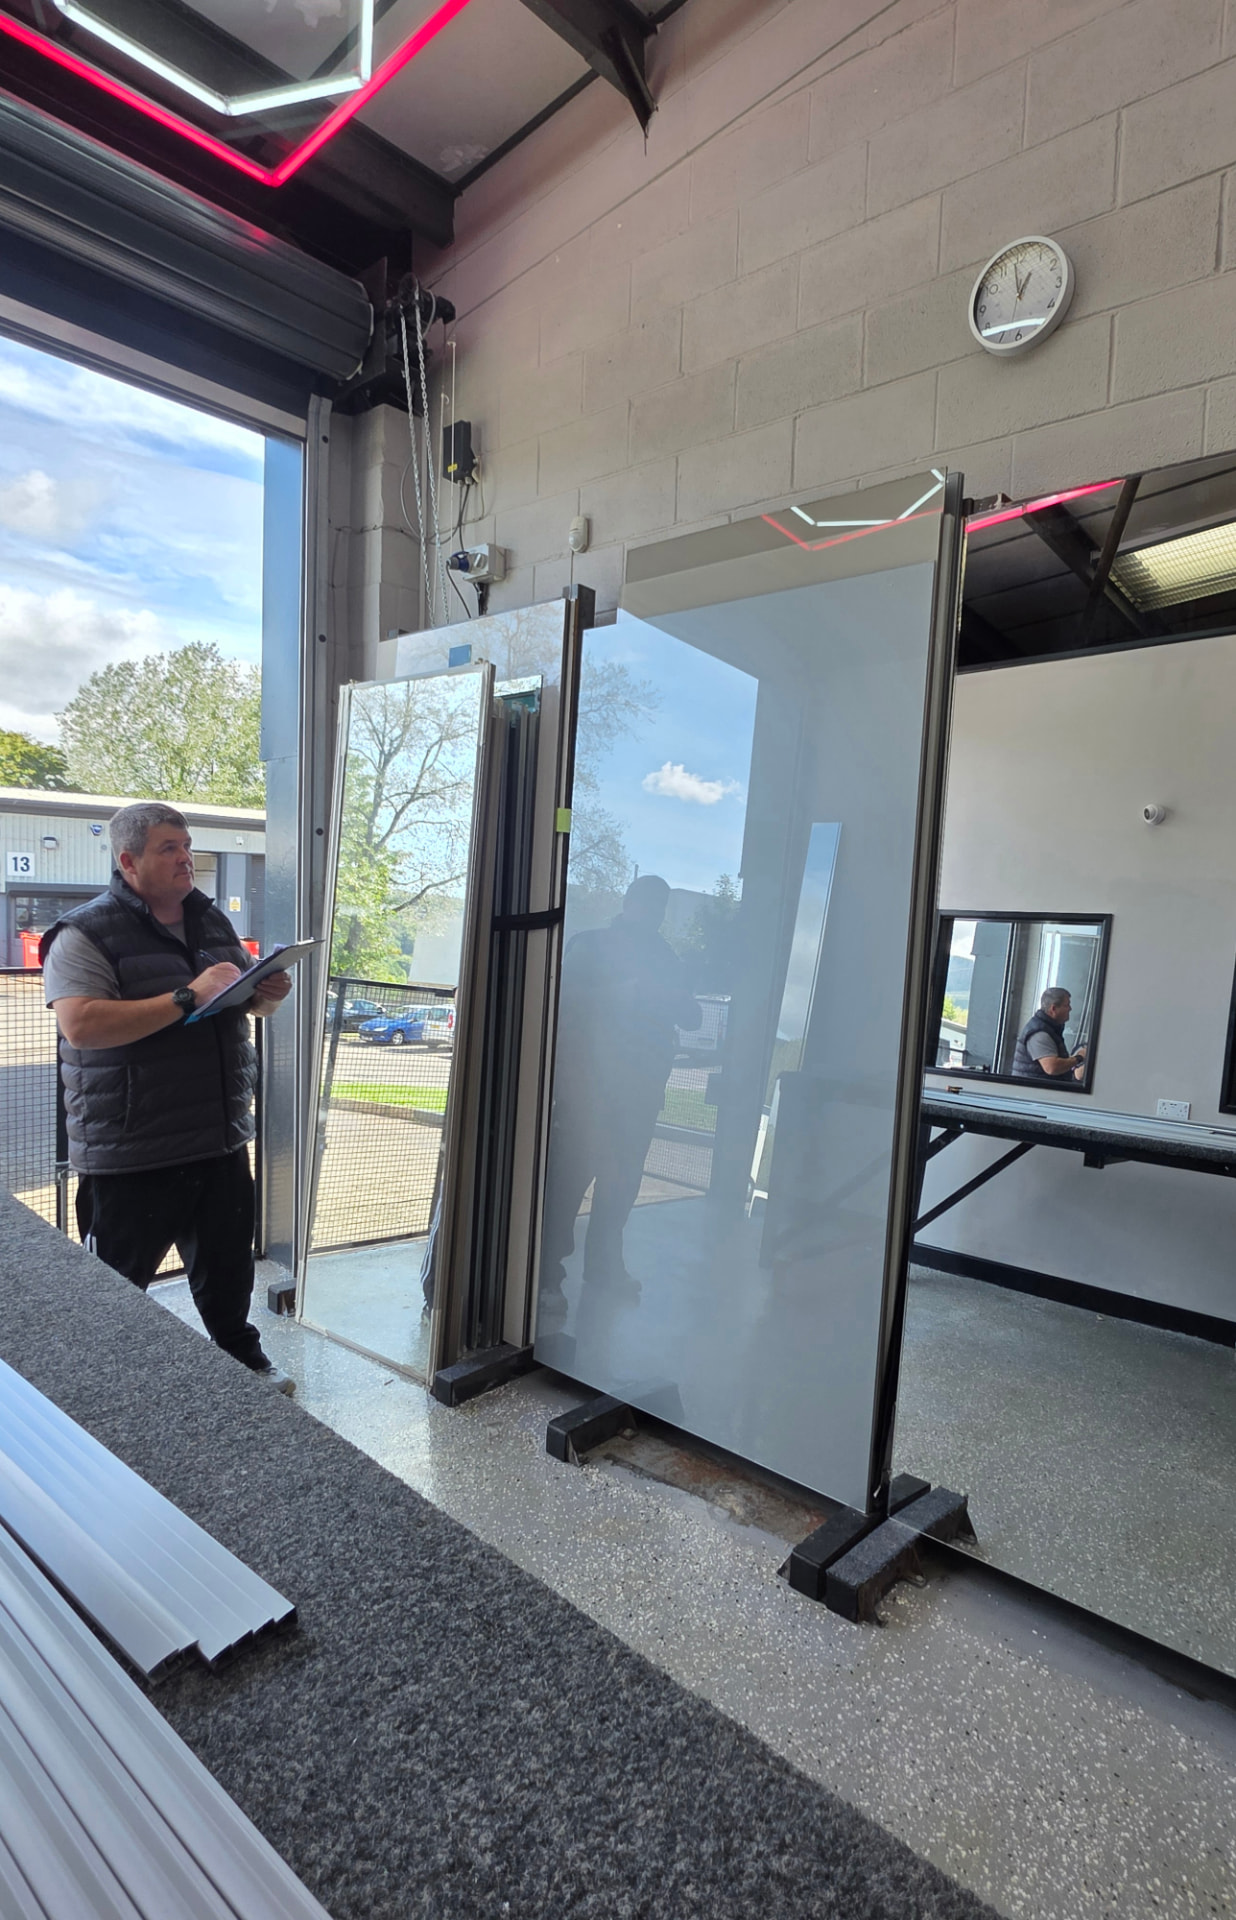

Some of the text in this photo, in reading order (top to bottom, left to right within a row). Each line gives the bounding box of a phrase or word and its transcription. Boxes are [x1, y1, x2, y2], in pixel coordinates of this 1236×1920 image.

[1049, 258, 1058, 272] 2
[1055, 276, 1063, 289] 3
[985, 283, 999, 297] 10
[1046, 298, 1056, 309] 4
[979, 304, 987, 317] 9
[999, 331, 1006, 343] 7
[1015, 329, 1023, 341] 6
[12, 856, 30, 872] 13
